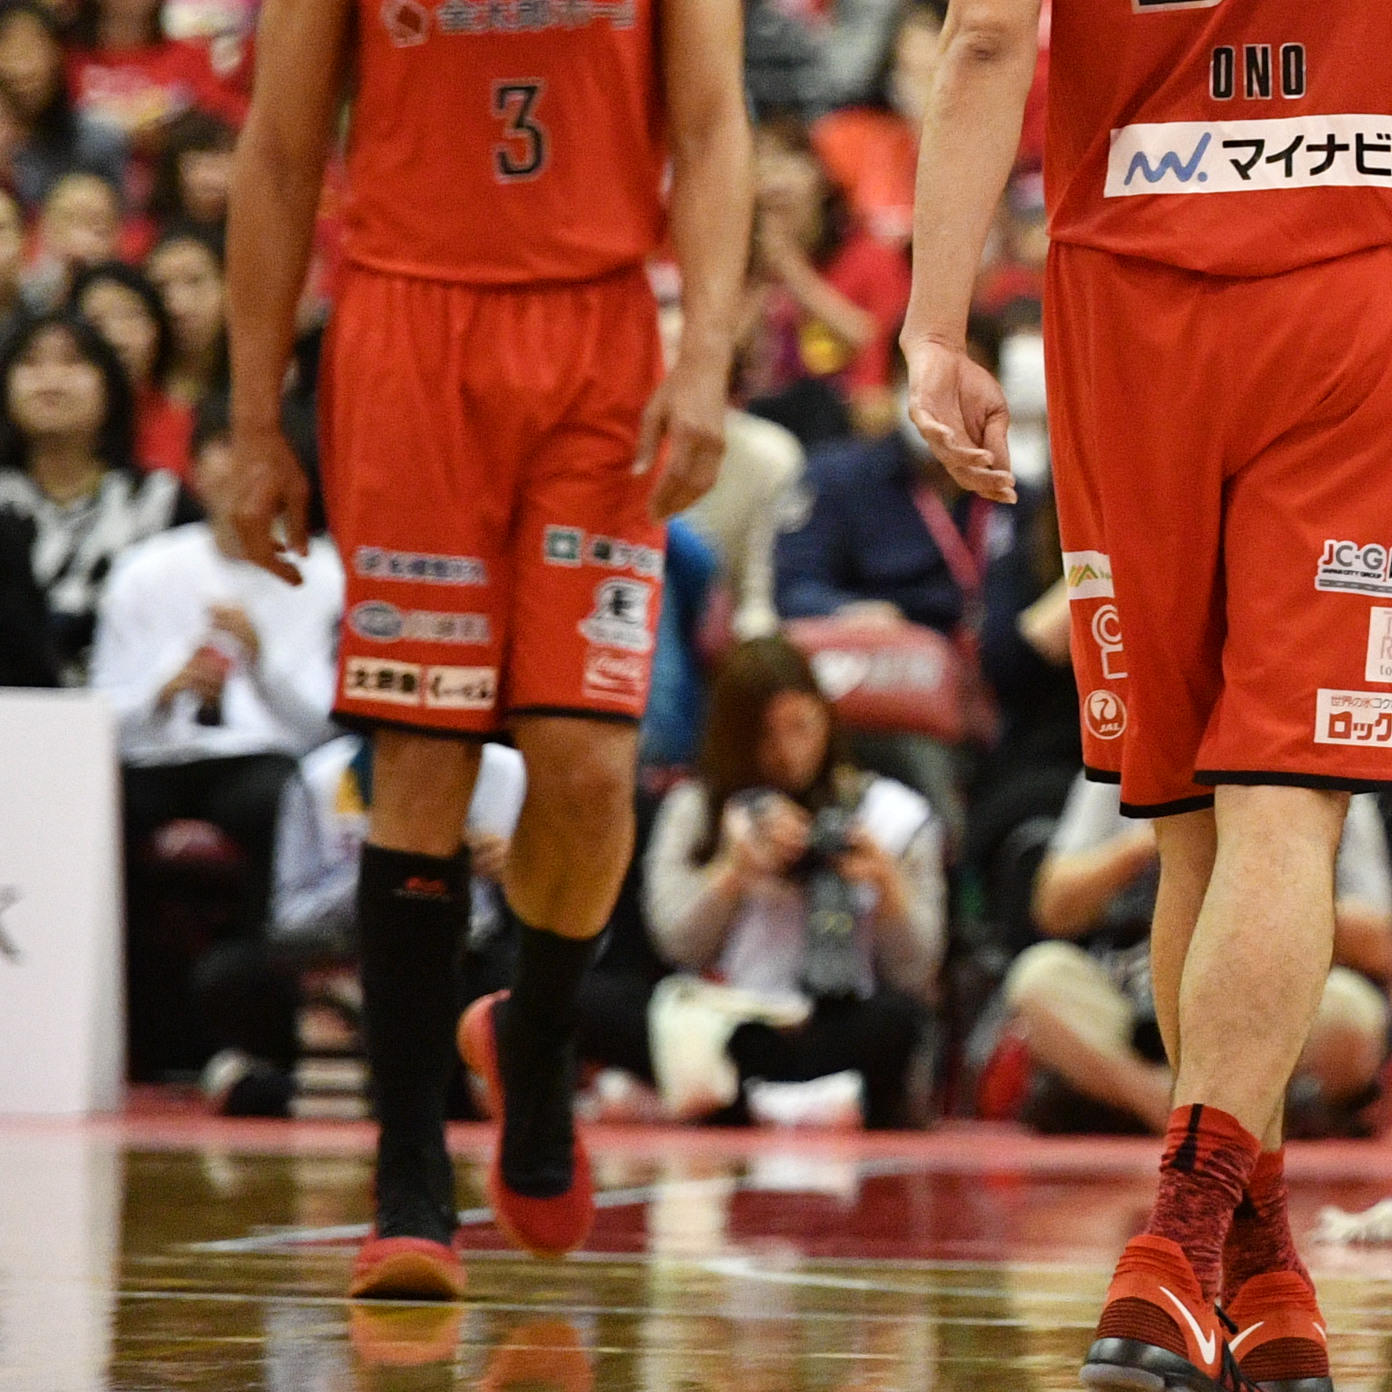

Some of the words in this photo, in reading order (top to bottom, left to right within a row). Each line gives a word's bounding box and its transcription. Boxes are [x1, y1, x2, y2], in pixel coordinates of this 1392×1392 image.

[1209, 42, 1308, 100] ONO
[491, 77, 549, 184] 3
[1221, 130, 1392, 181] マイナビ
